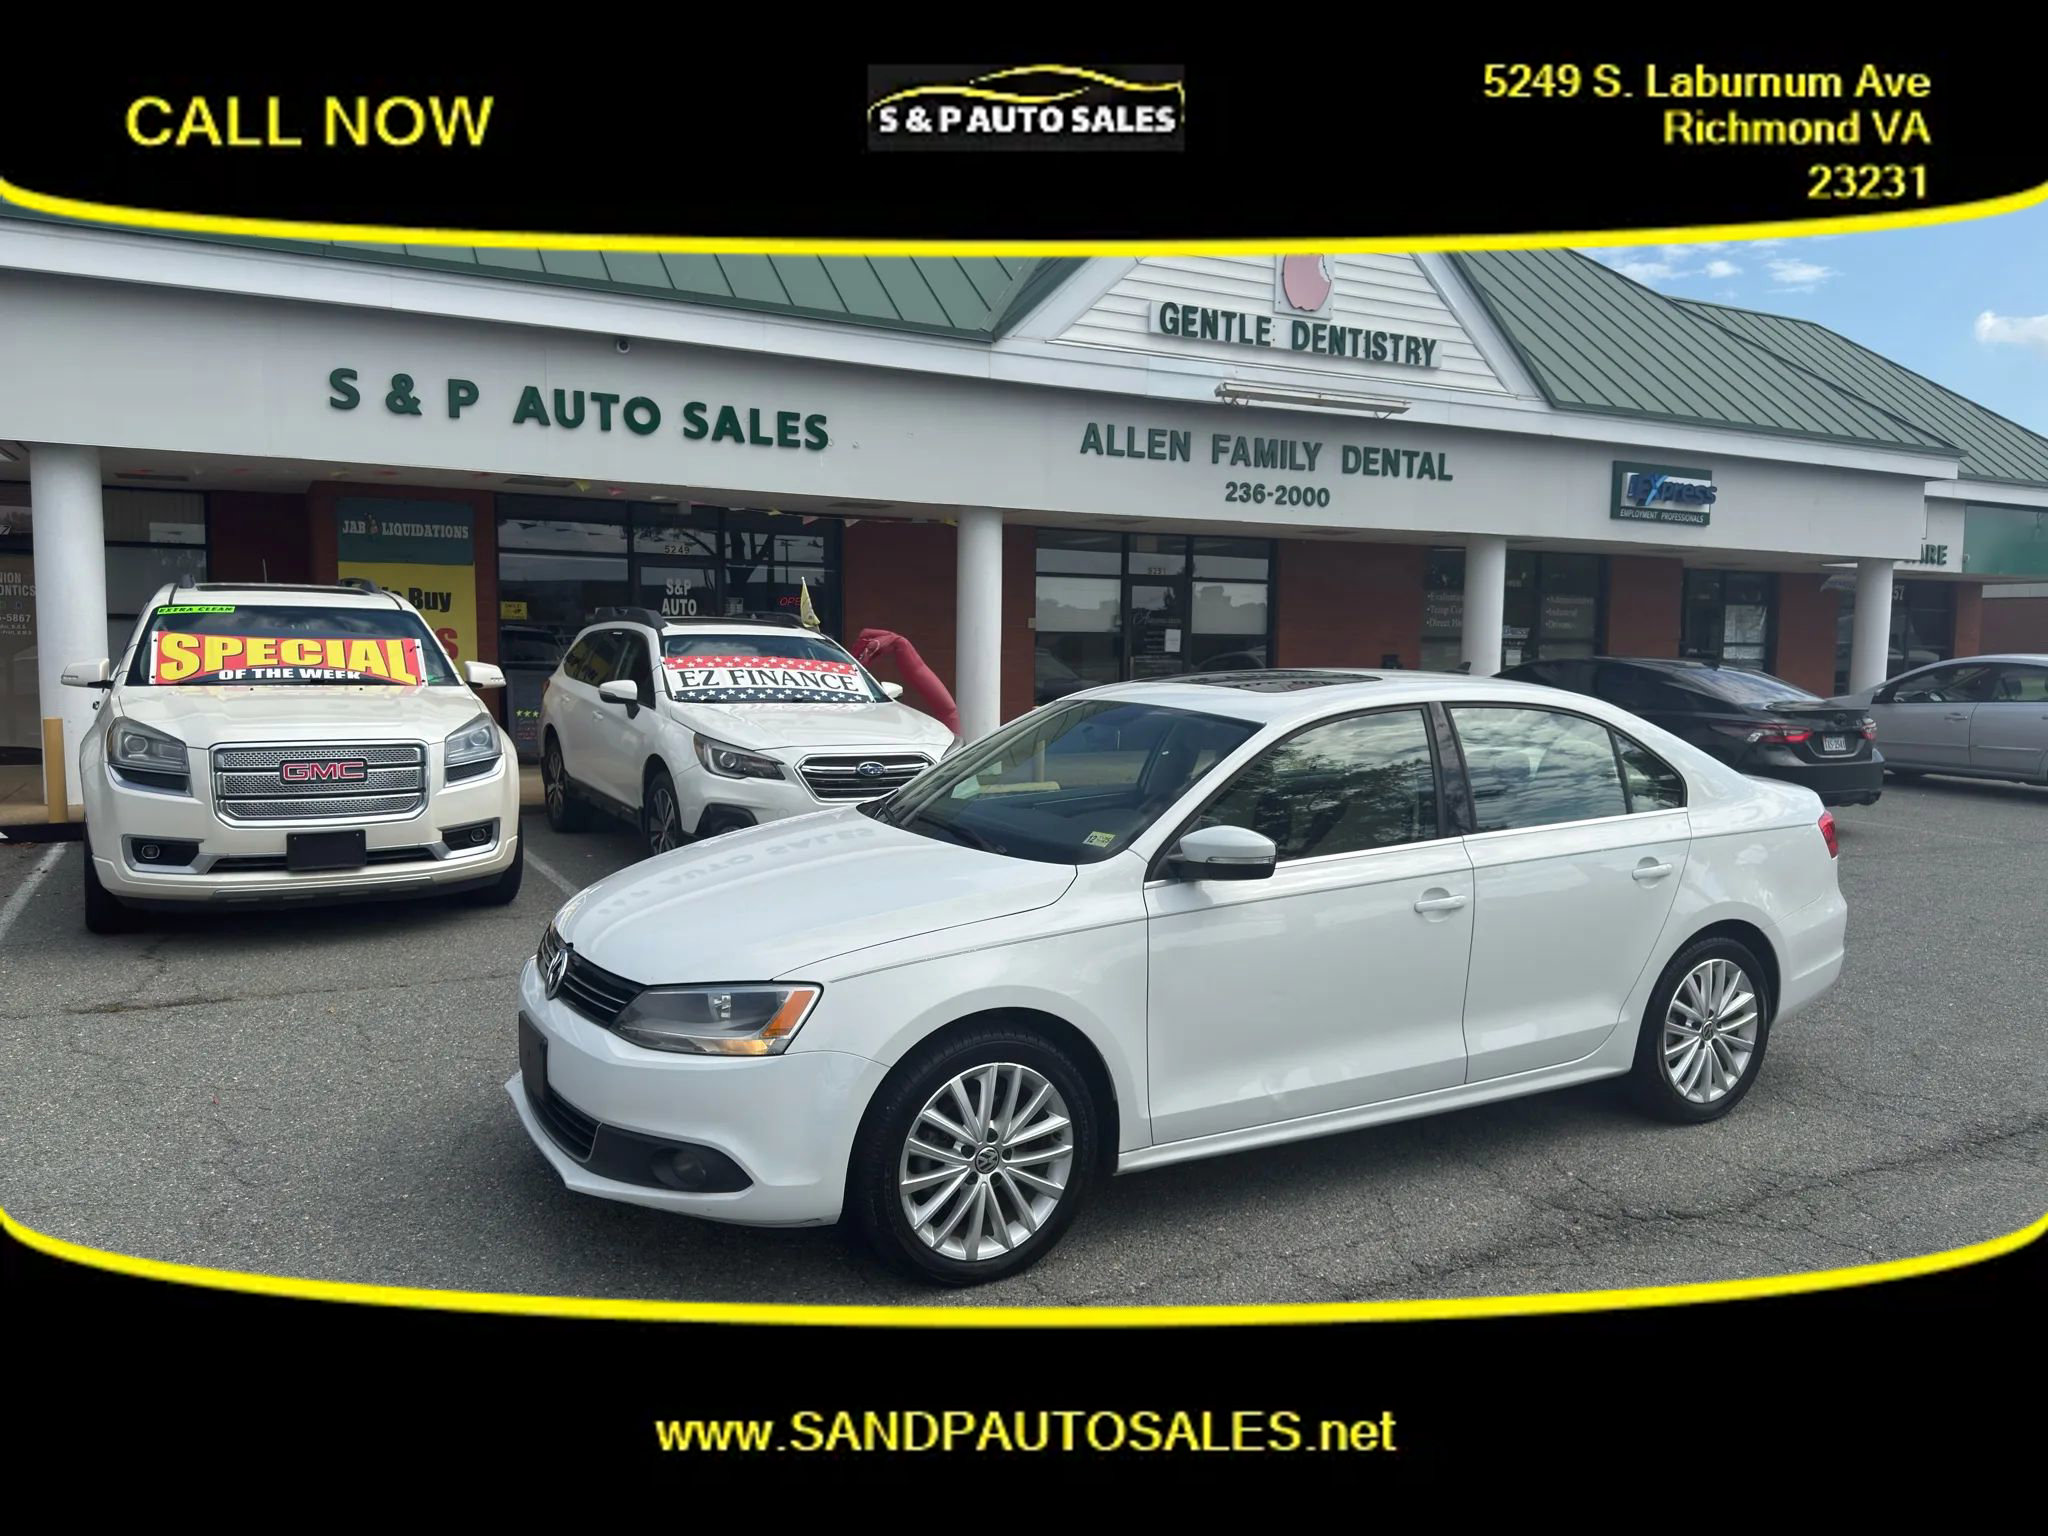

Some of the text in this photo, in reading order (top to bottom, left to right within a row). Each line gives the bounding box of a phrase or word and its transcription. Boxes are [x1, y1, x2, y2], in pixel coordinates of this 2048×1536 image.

[1159, 301, 1438, 367] GENTLE DENTISTRY
[329, 368, 829, 451] S & P AUTO SALES
[1079, 422, 1454, 481] ALLEN FAMILY DENTAL
[1225, 481, 1331, 507] 236-2000
[1620, 508, 1705, 523] EMPLOYMENT PROFESSIONALS
[342, 519, 469, 540] JAB LIQUIDATIONS
[664, 544, 691, 555] 5249
[666, 577, 692, 596] S&P
[407, 587, 452, 613] Buy
[661, 598, 697, 616] AUTO
[779, 596, 802, 607] OPE
[0, 613, 31, 623] -5867
[160, 632, 418, 686] SPECIAL
[218, 667, 361, 681] OF THE WEEK
[676, 669, 860, 692] EZ FINANCE
[282, 761, 366, 781] GMC
